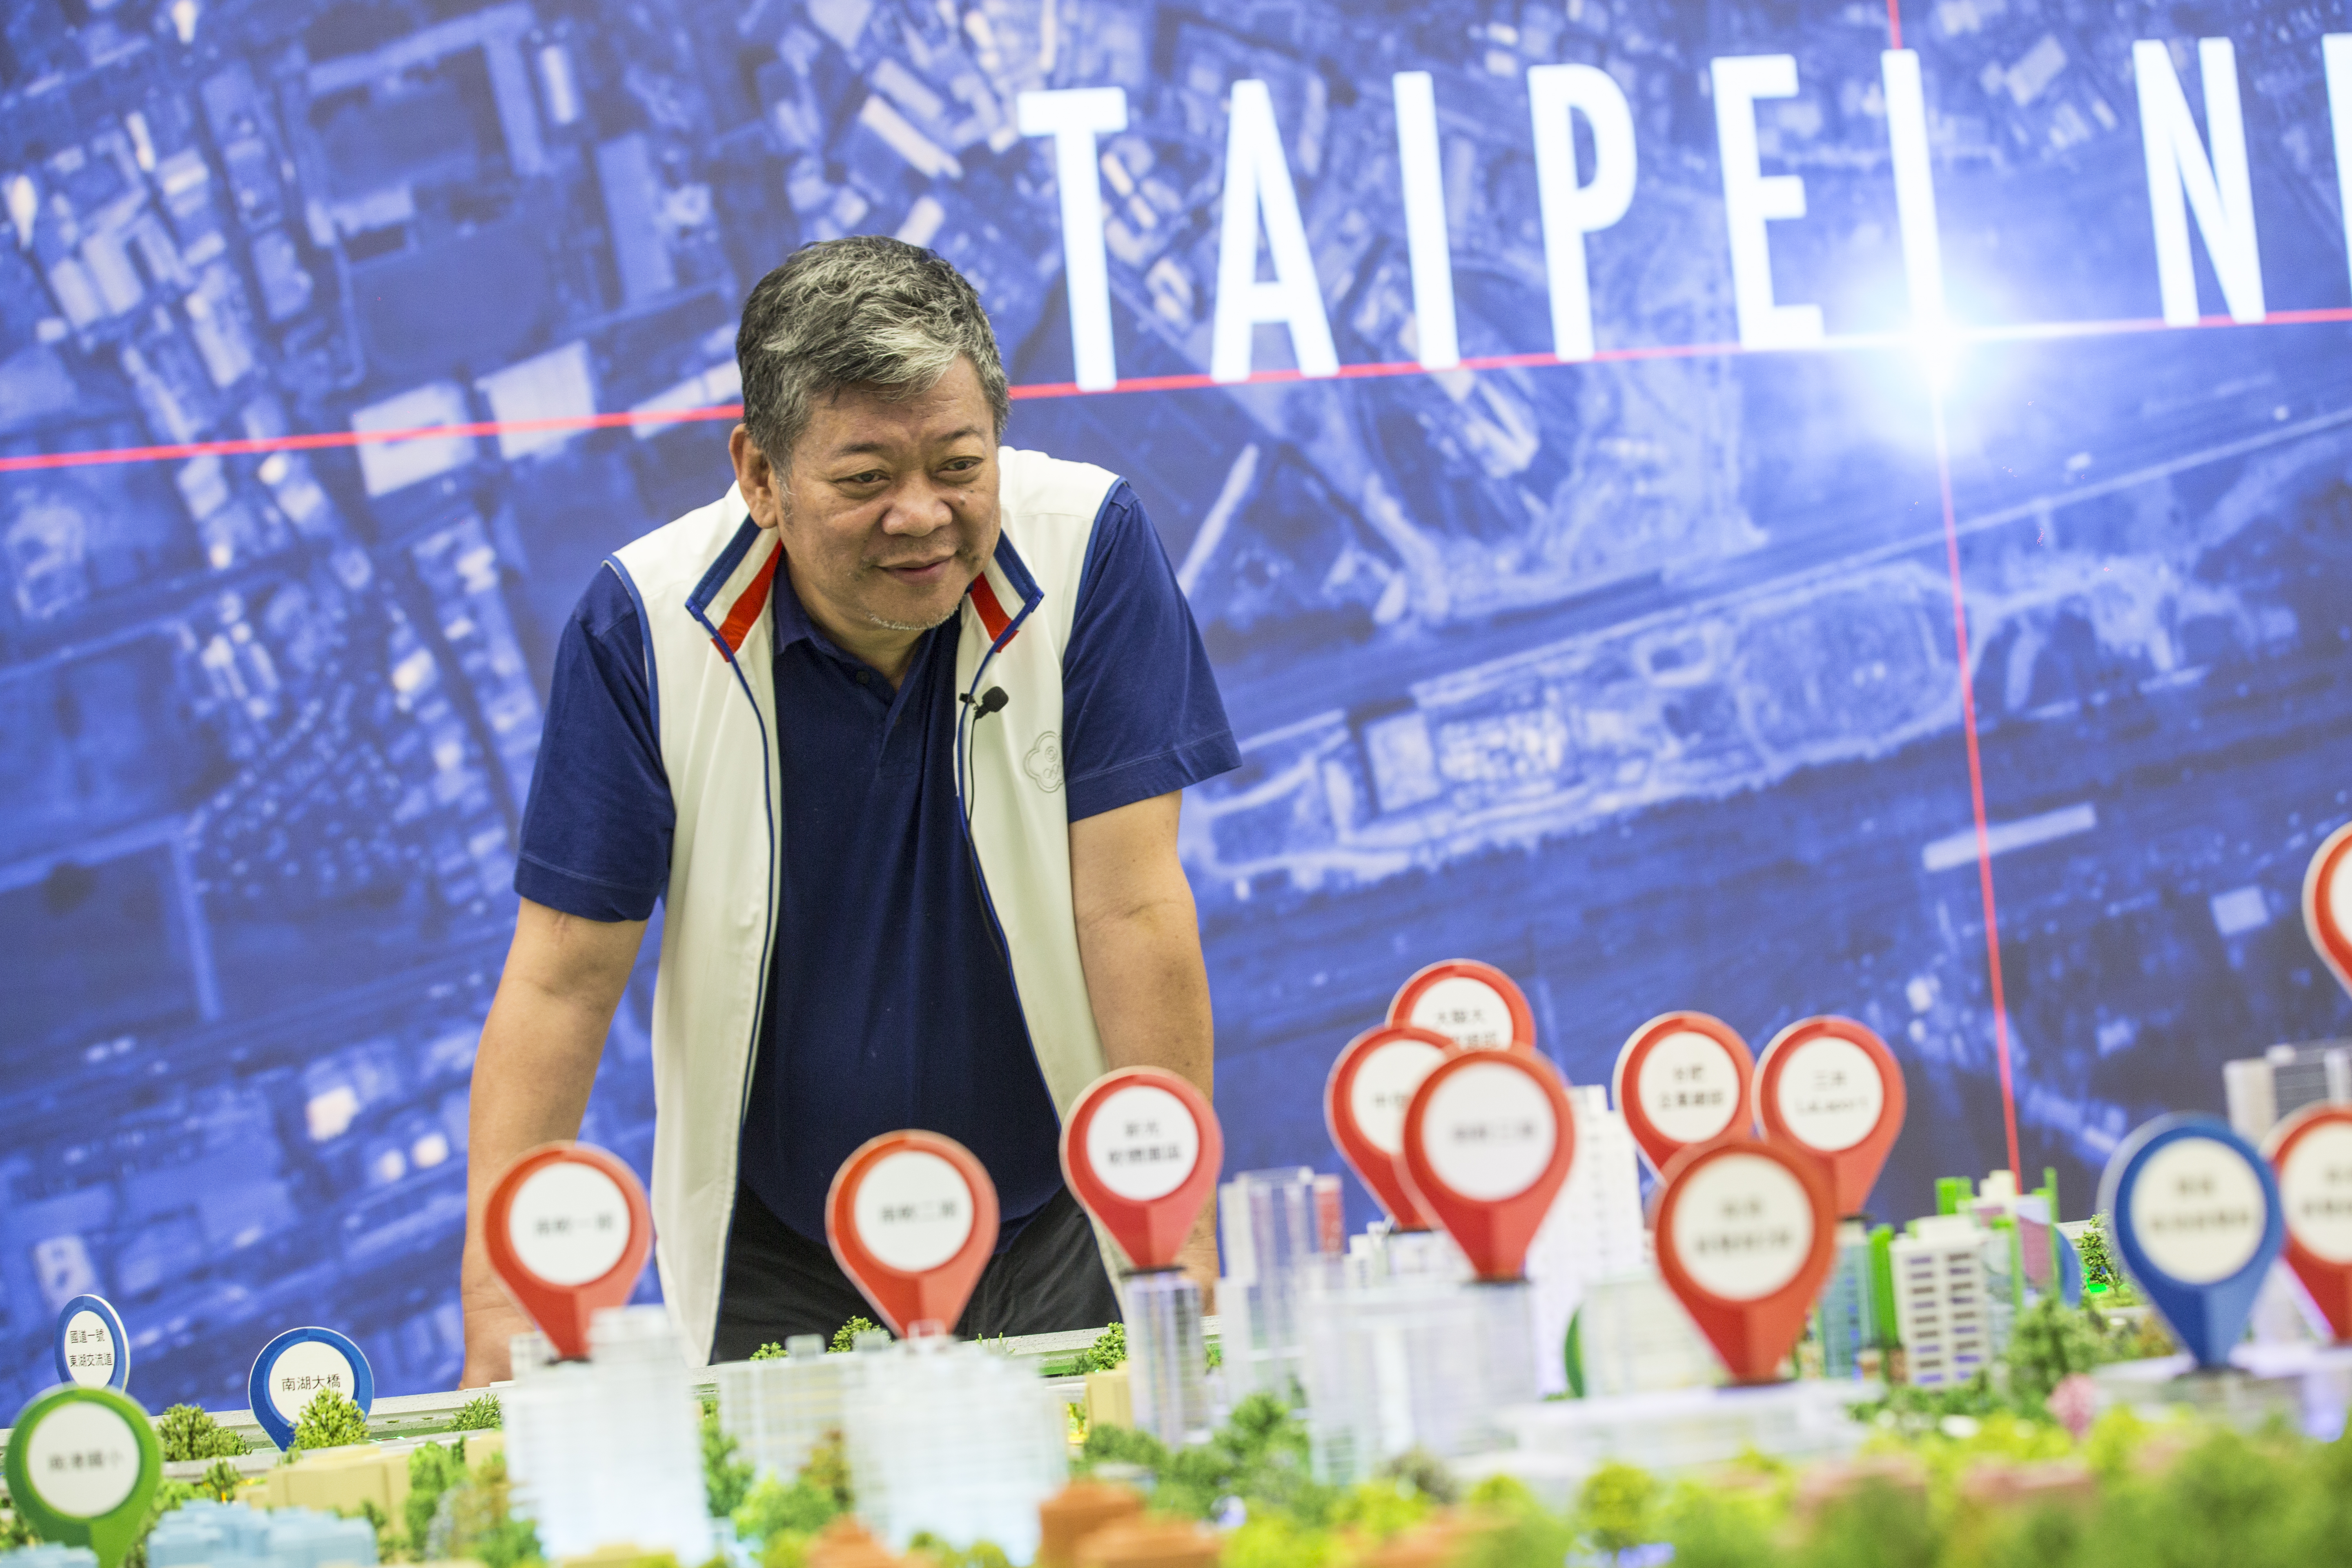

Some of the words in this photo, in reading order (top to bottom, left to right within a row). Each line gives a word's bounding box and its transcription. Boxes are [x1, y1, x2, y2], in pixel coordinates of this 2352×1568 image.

[1017, 48, 1947, 391] TAIPEI
[2132, 32, 2352, 327] N
[70, 1329, 105, 1343] 國道一號
[69, 1352, 113, 1367] 東湖交流道
[282, 1373, 341, 1392] 南湖大橋
